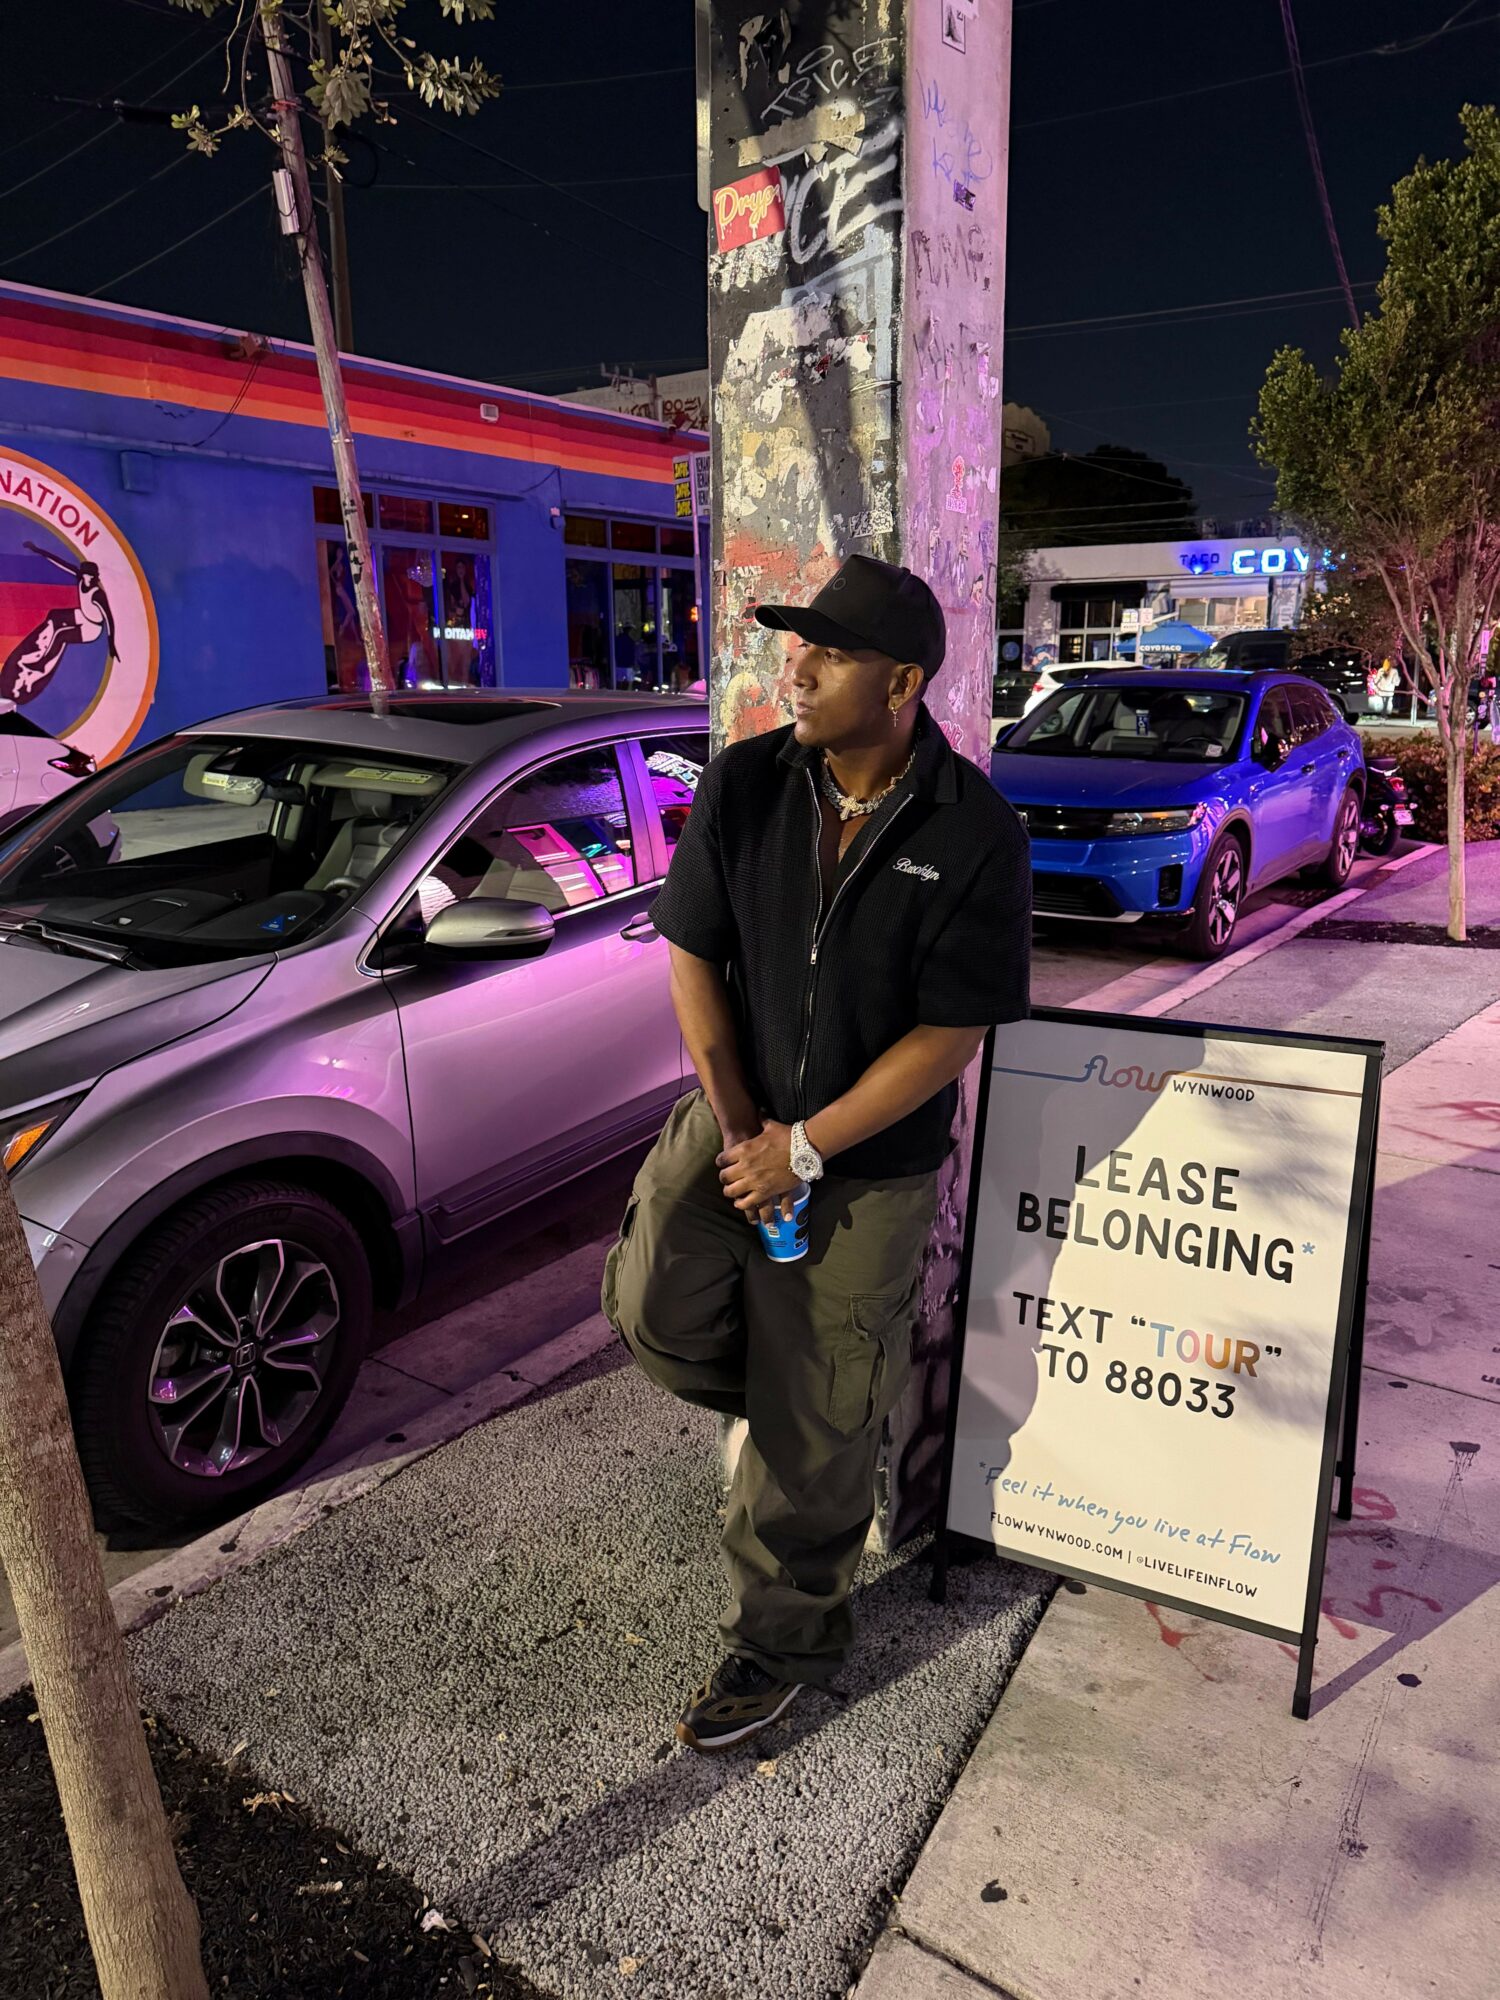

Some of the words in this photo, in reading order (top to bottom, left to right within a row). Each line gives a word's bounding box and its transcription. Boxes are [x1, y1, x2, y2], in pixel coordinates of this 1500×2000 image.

[1180, 553, 1220, 565] TACO
[1232, 548, 1338, 575] COY
[1083, 1055, 1172, 1093] flow
[1173, 1079, 1256, 1103] WYNWOOD
[1075, 1145, 1240, 1212] LEASE
[1013, 1291, 1113, 1344] TEXT
[1042, 1343, 1088, 1384] TO
[1105, 1359, 1237, 1419] 88033
[990, 1511, 1123, 1560] FLOWWYNWOOD.COM
[1136, 1554, 1258, 1598] @LIVELIFEINFLOW
[1032, 1482, 1054, 1503] it
[1056, 1493, 1108, 1520] when
[1108, 1508, 1149, 1533] you
[1153, 1517, 1191, 1543] live
[1196, 1528, 1226, 1549] at
[1229, 1533, 1282, 1565] Flow
